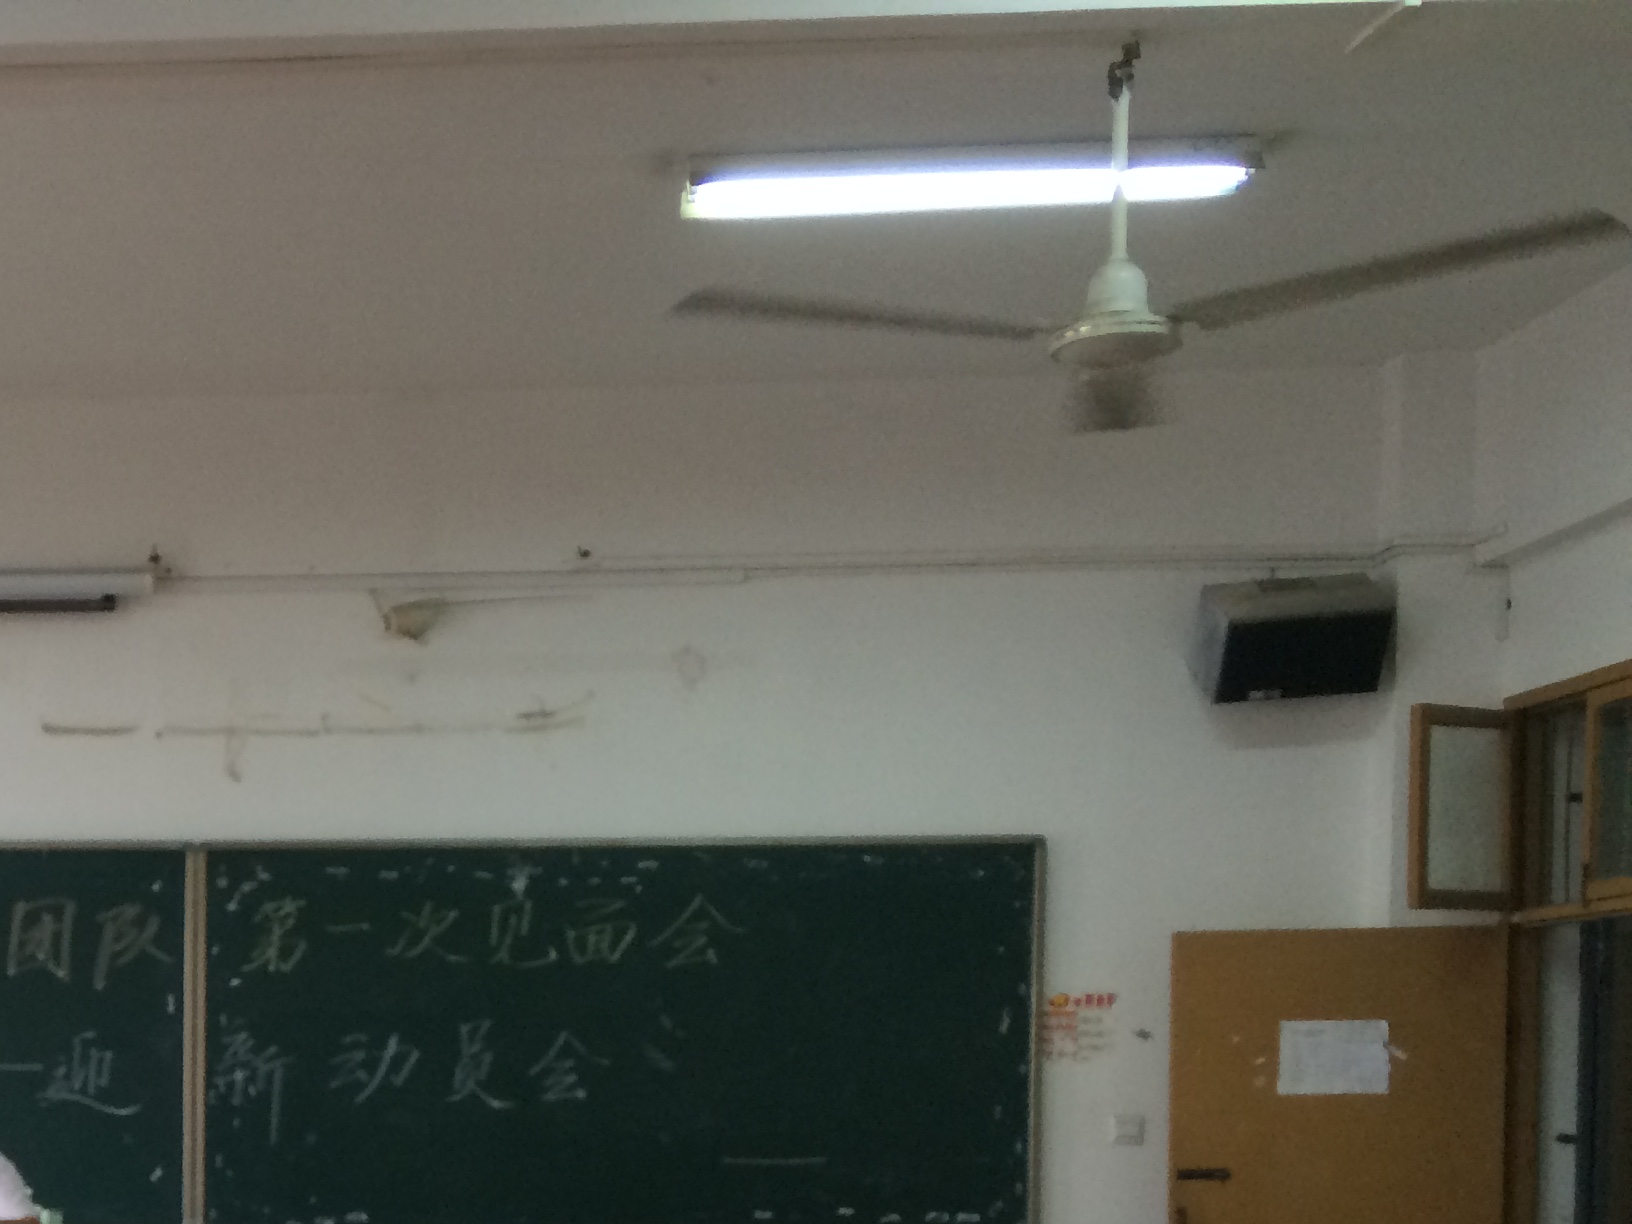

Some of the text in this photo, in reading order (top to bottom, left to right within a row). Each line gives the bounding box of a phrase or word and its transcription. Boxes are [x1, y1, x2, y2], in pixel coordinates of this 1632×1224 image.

[240, 893, 746, 972] 第一次见面会
